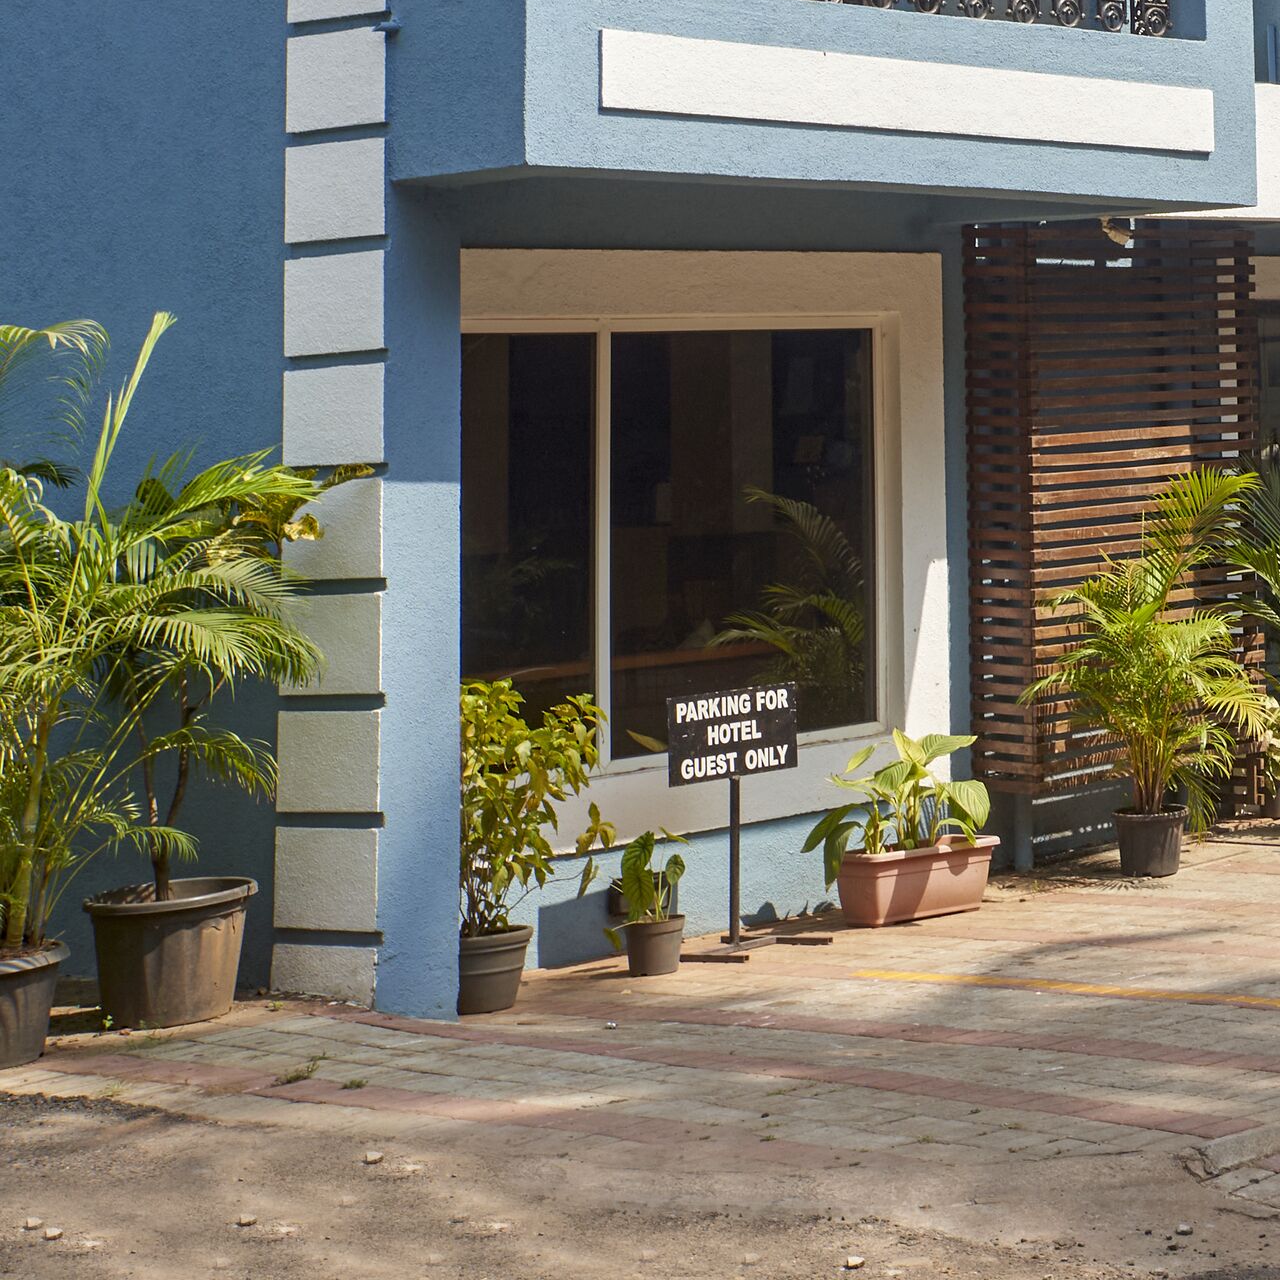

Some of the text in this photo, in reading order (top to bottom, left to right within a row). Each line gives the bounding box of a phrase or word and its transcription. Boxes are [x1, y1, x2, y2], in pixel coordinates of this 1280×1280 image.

[675, 688, 788, 724] PARKING FOR
[707, 719, 762, 746] HOTEL
[680, 744, 789, 780] GUEST ONLY
